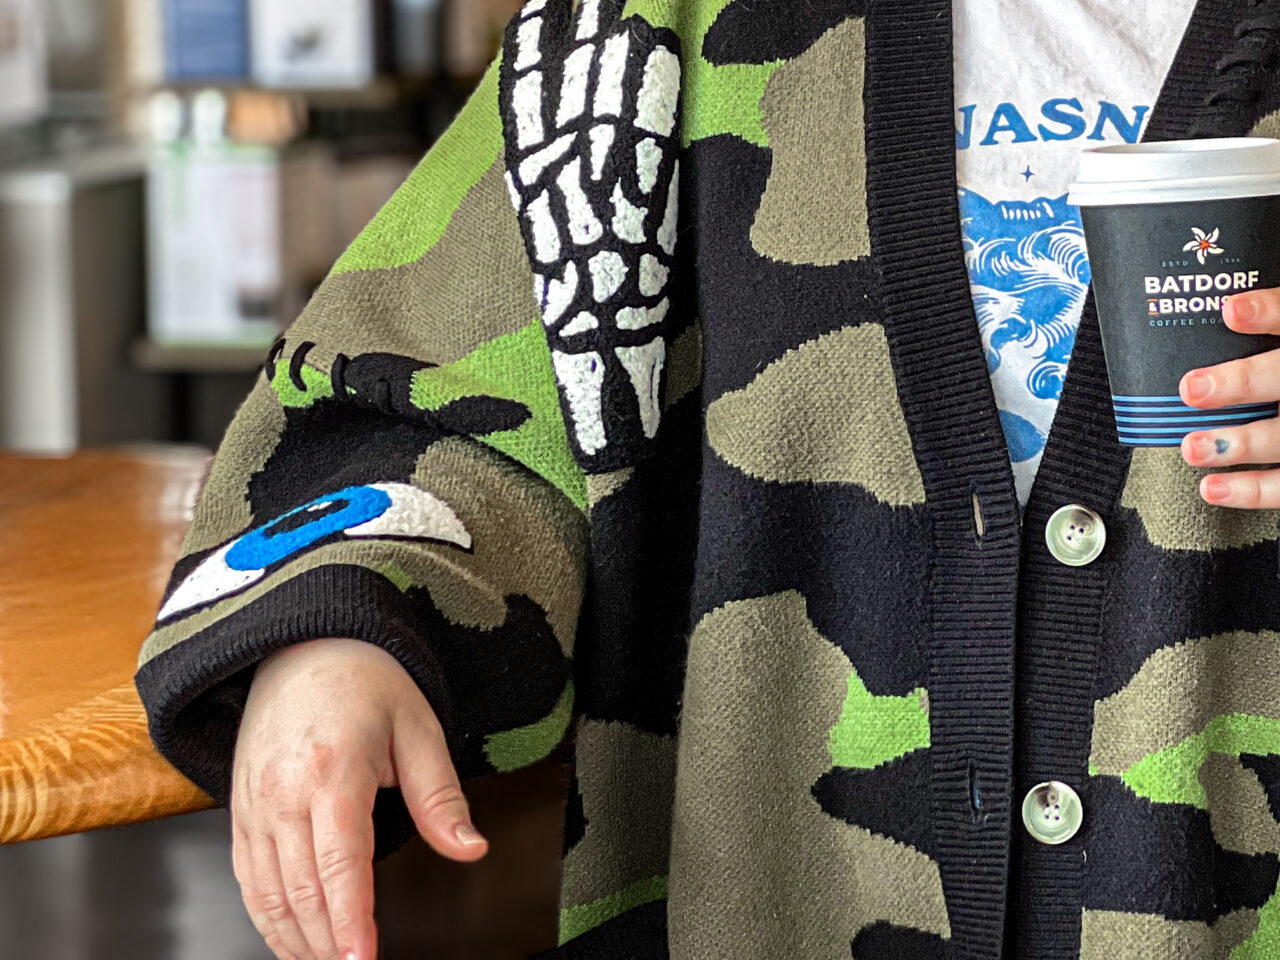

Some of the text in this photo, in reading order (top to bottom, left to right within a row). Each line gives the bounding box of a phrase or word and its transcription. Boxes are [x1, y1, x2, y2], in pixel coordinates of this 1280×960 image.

[1161, 260, 1189, 268] ESTD
[1144, 270, 1260, 294] BATDORF
[1149, 318, 1196, 327] COFFEE
